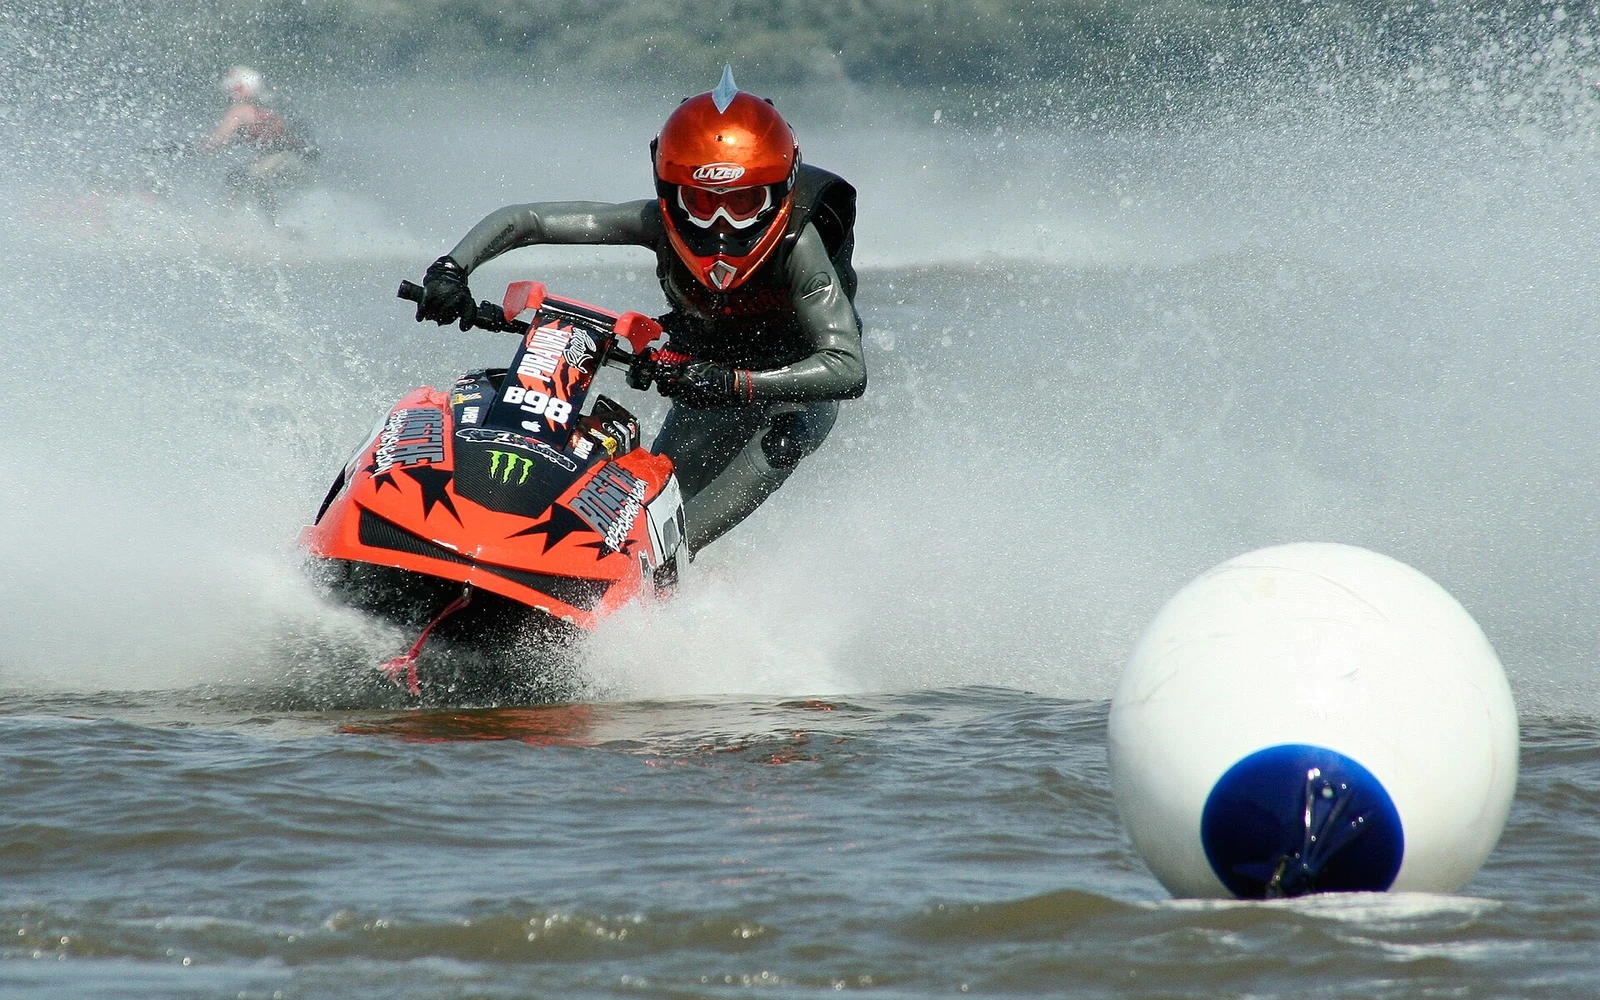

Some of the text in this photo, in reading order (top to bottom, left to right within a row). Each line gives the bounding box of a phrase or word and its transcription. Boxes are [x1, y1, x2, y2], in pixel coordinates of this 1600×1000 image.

[698, 167, 743, 180] LAZER
[516, 326, 571, 382] PIRANHA
[503, 386, 572, 424] B98
